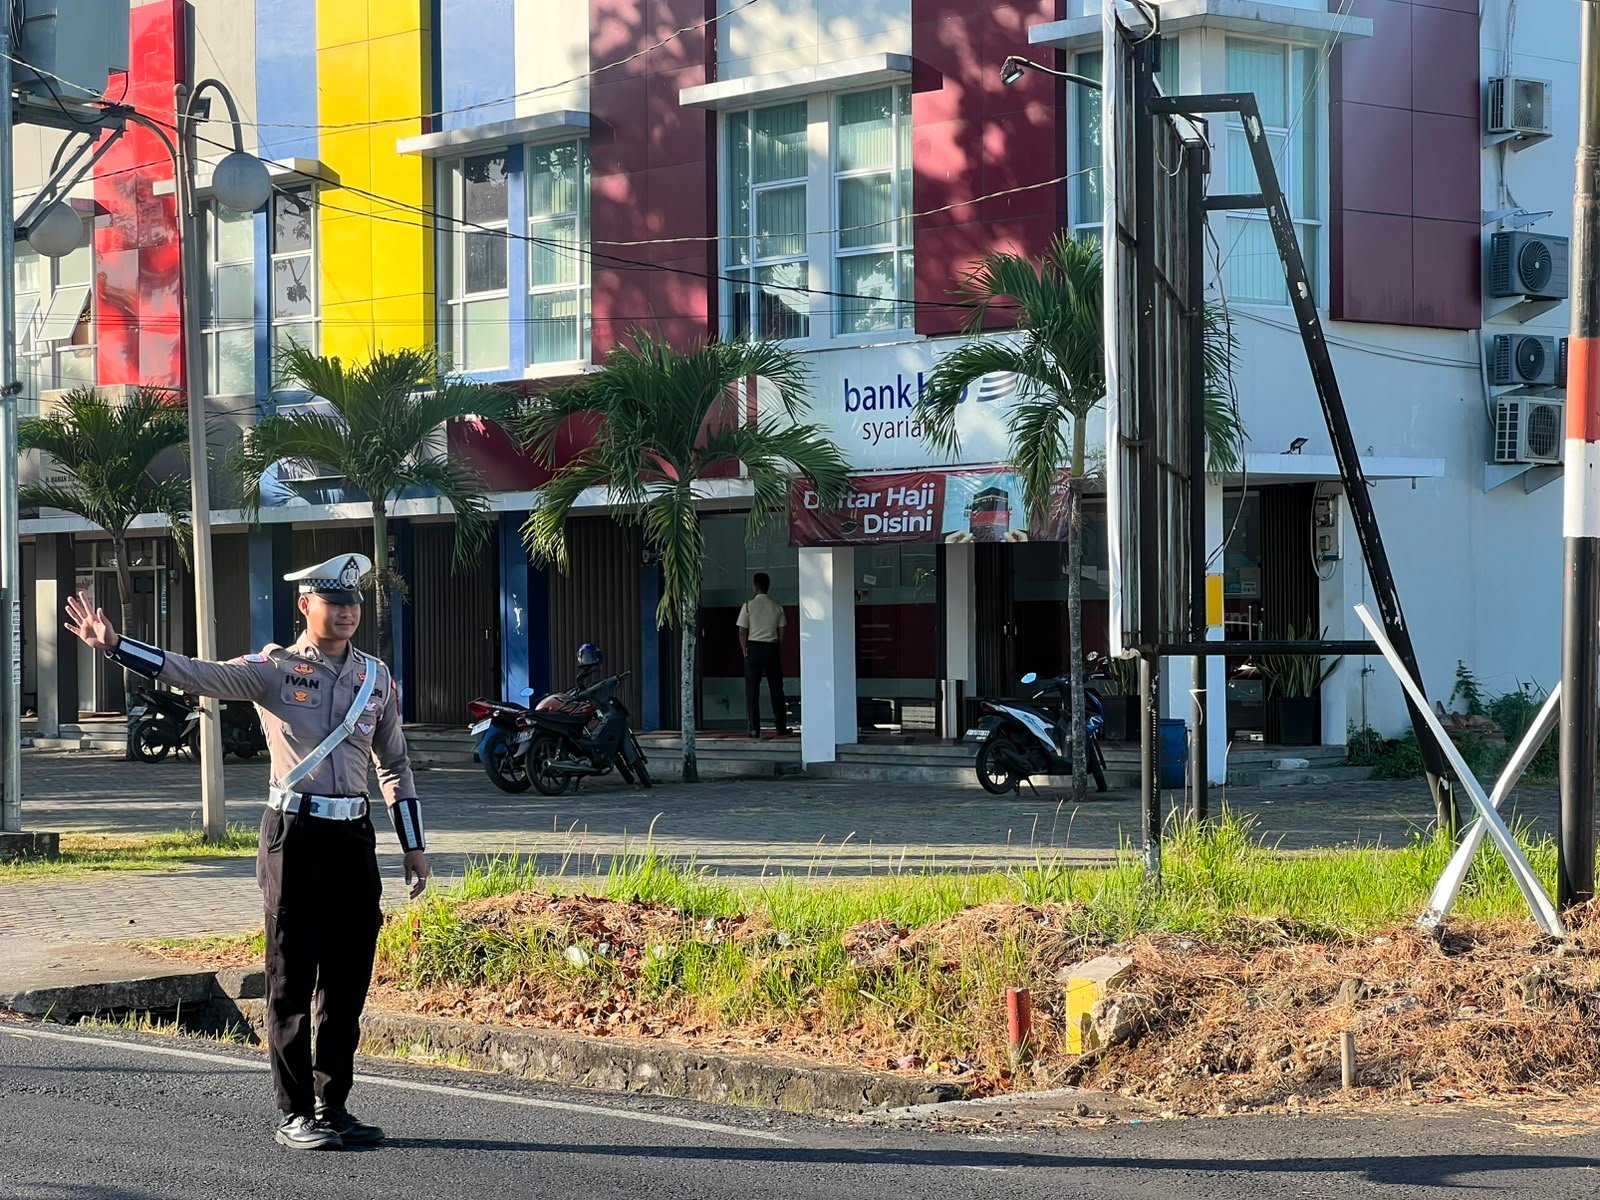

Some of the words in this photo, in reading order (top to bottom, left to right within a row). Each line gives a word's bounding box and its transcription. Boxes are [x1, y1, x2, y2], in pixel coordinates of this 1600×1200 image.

[844, 373, 912, 413] bank
[803, 490, 882, 509] Dftar
[886, 482, 936, 510] Haji
[863, 509, 933, 534] Disini
[285, 674, 320, 690] IVAN
